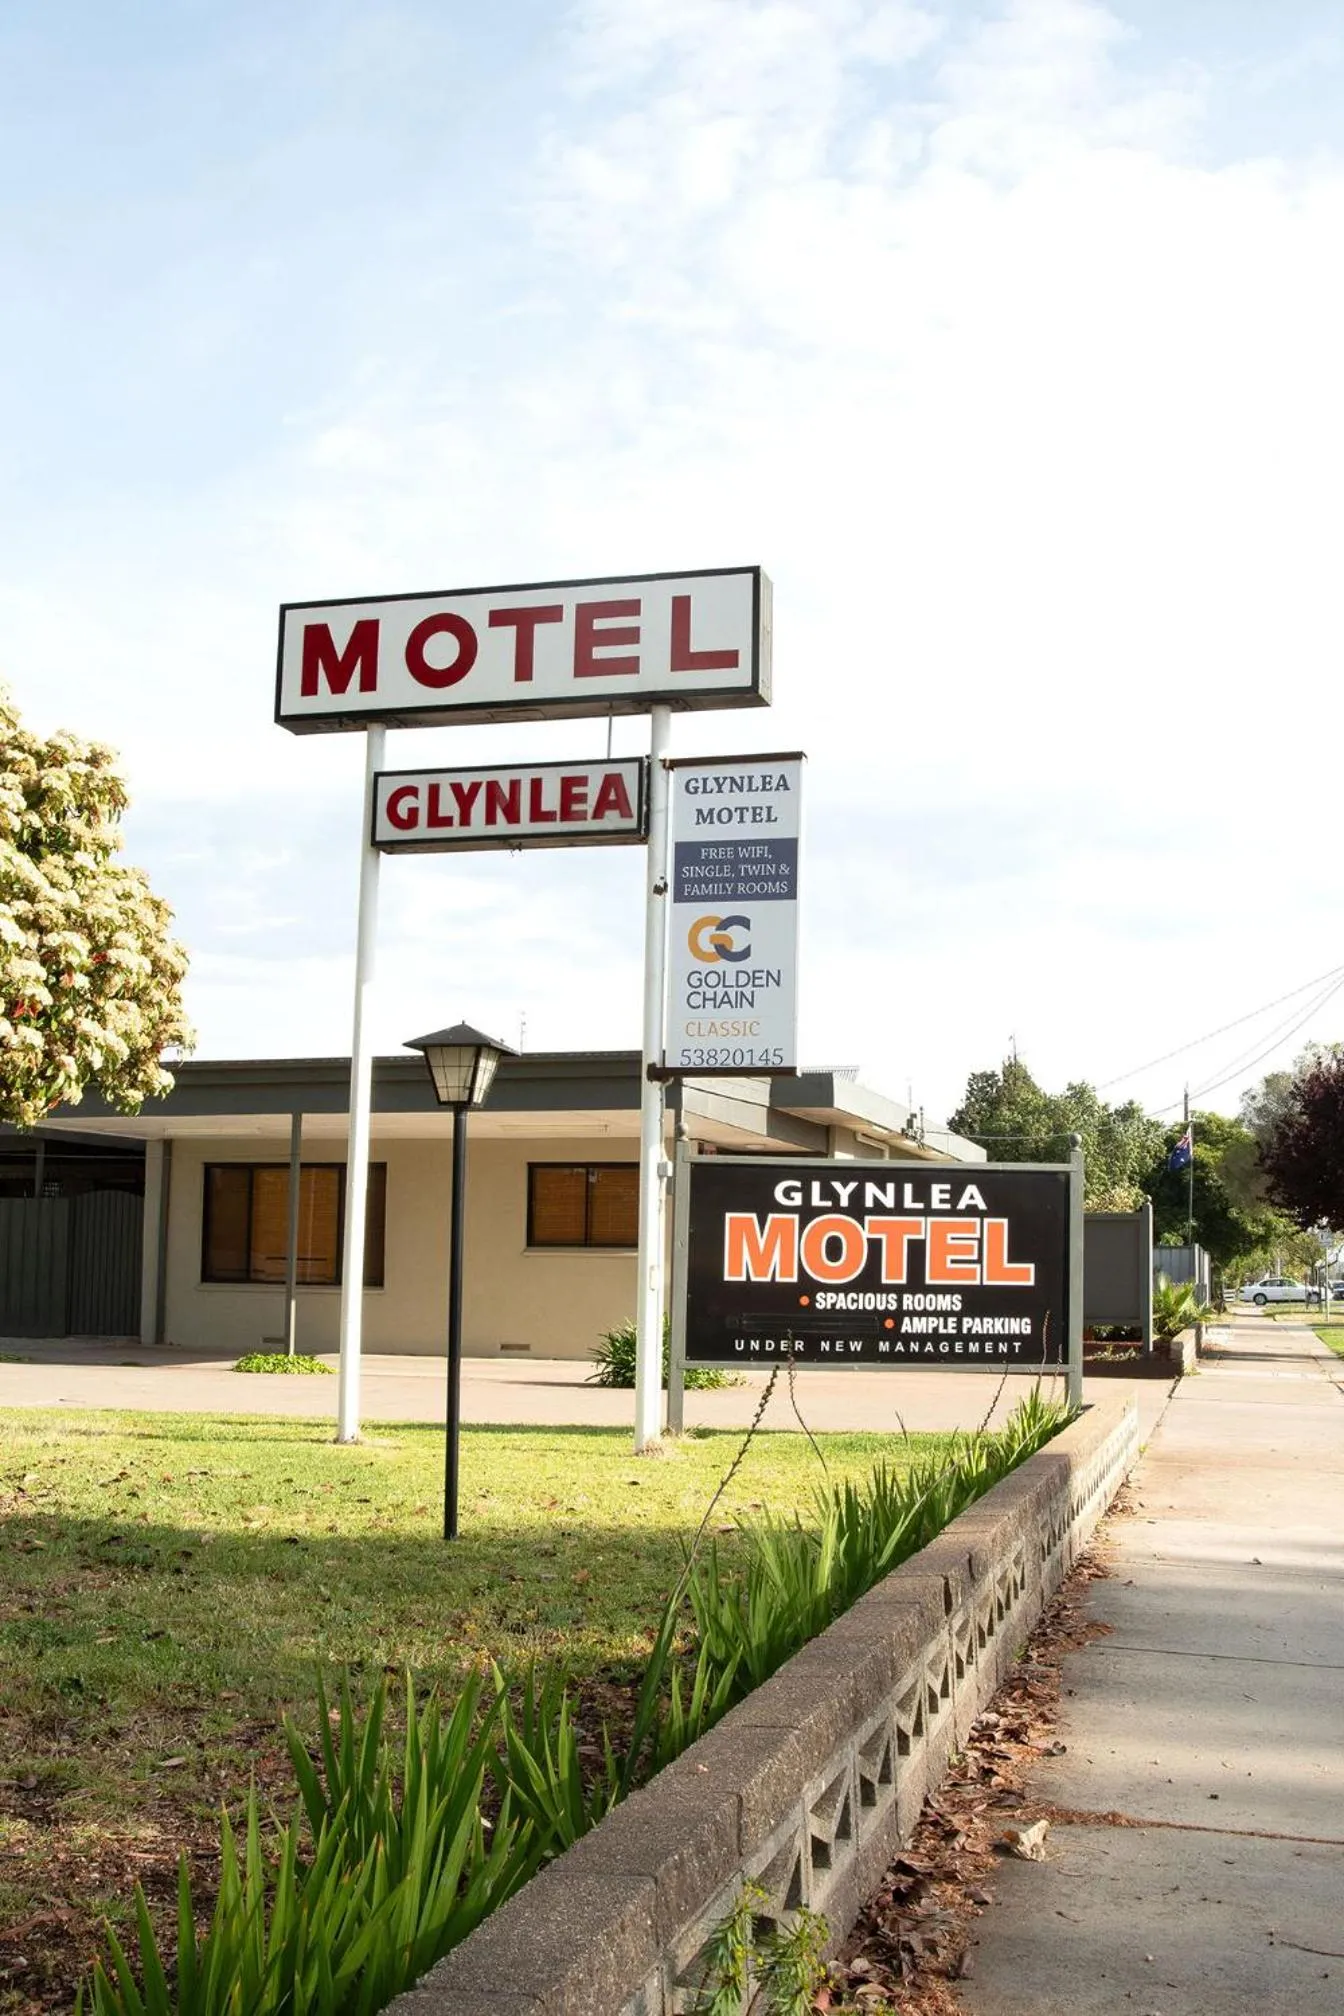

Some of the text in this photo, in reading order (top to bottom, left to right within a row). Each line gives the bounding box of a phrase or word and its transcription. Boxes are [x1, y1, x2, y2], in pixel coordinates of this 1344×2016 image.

[300, 594, 740, 697] MOTEL
[684, 773, 791, 795] GLYNLEA
[386, 772, 634, 831] GLYNLEA
[695, 805, 778, 826] MOTEL
[701, 845, 773, 860] FREE WIFI,
[739, 864, 776, 877] TWIN
[778, 864, 790, 876] &
[683, 881, 788, 896] FAMILY ROOMS
[686, 969, 781, 989] GOLDEN
[686, 991, 755, 1010] CHAIN
[685, 1020, 760, 1037] CLASSIC
[680, 1047, 784, 1067] 53820145
[773, 1180, 988, 1210] GLYNLEA
[723, 1212, 1036, 1286] MOTEL
[815, 1292, 963, 1312] SPACIOUS ROOMS
[901, 1316, 1032, 1335] AMPLE PARKING
[734, 1339, 1023, 1354] UNDER NEW MANAGEMENT
